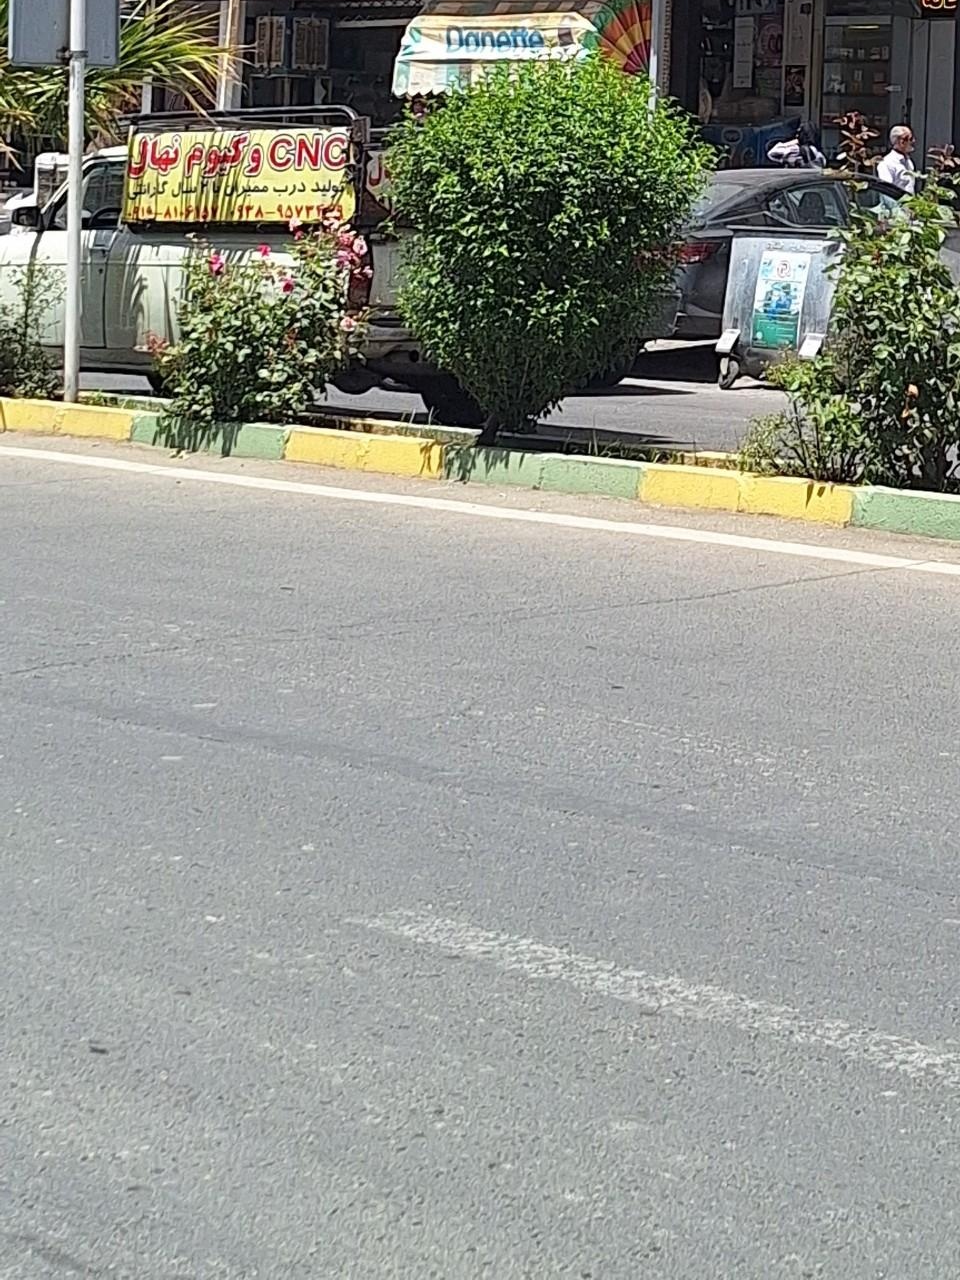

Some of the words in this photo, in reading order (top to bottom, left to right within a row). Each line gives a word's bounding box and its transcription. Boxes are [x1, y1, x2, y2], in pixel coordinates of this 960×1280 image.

[446, 26, 545, 52] Danette
[267, 135, 348, 170] CNC
[172, 181, 198, 198] سال
[272, 181, 307, 197] درب
[310, 179, 345, 199] تولید
